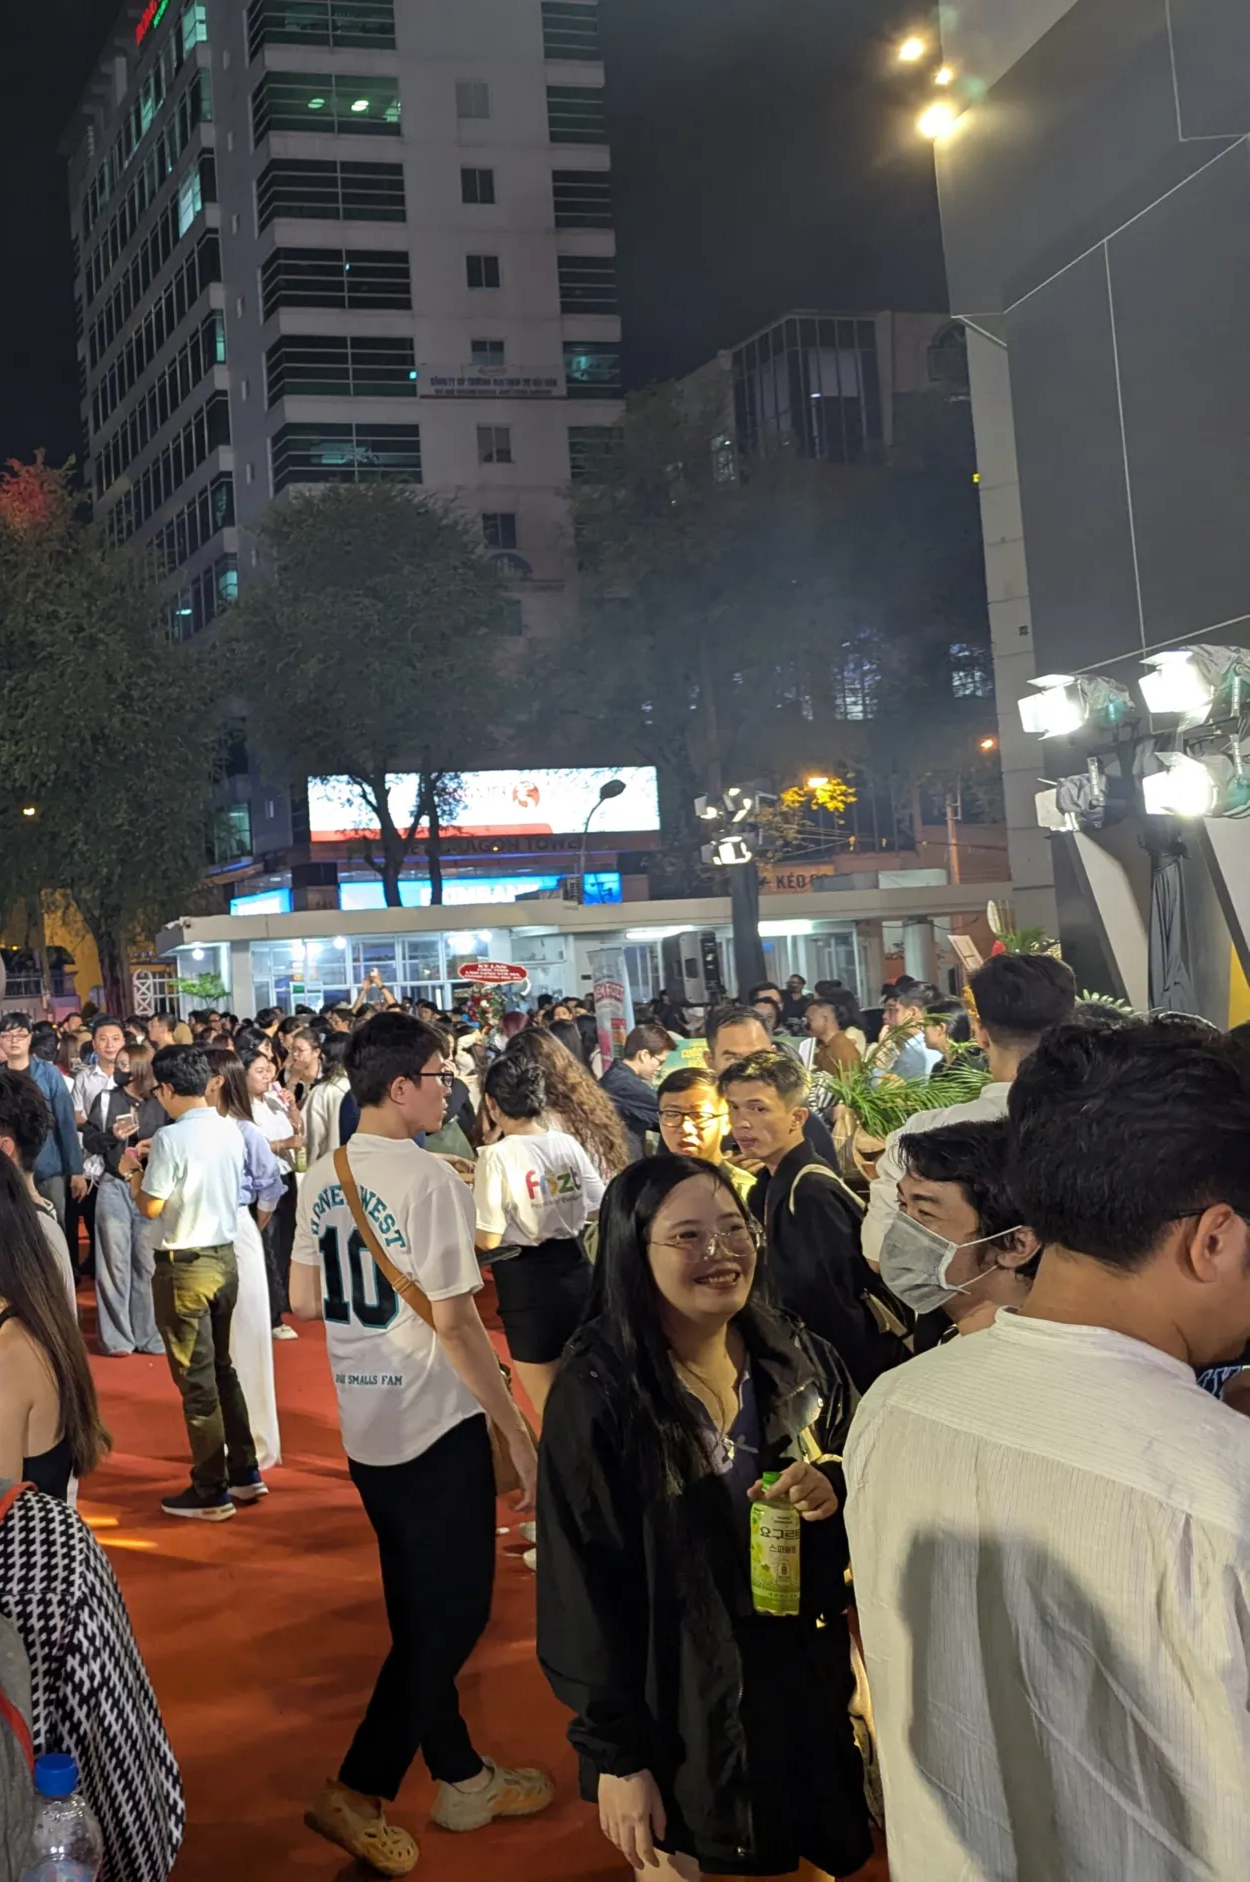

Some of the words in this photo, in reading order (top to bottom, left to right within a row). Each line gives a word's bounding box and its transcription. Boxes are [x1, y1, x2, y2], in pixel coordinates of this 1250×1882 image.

[447, 837, 522, 854] RAGON
[310, 1184, 345, 1236] HONE
[359, 1184, 407, 1249] WEST
[318, 1224, 399, 1330] 10
[348, 1374, 378, 1385] SMALLS
[381, 1375, 403, 1386] FAM
